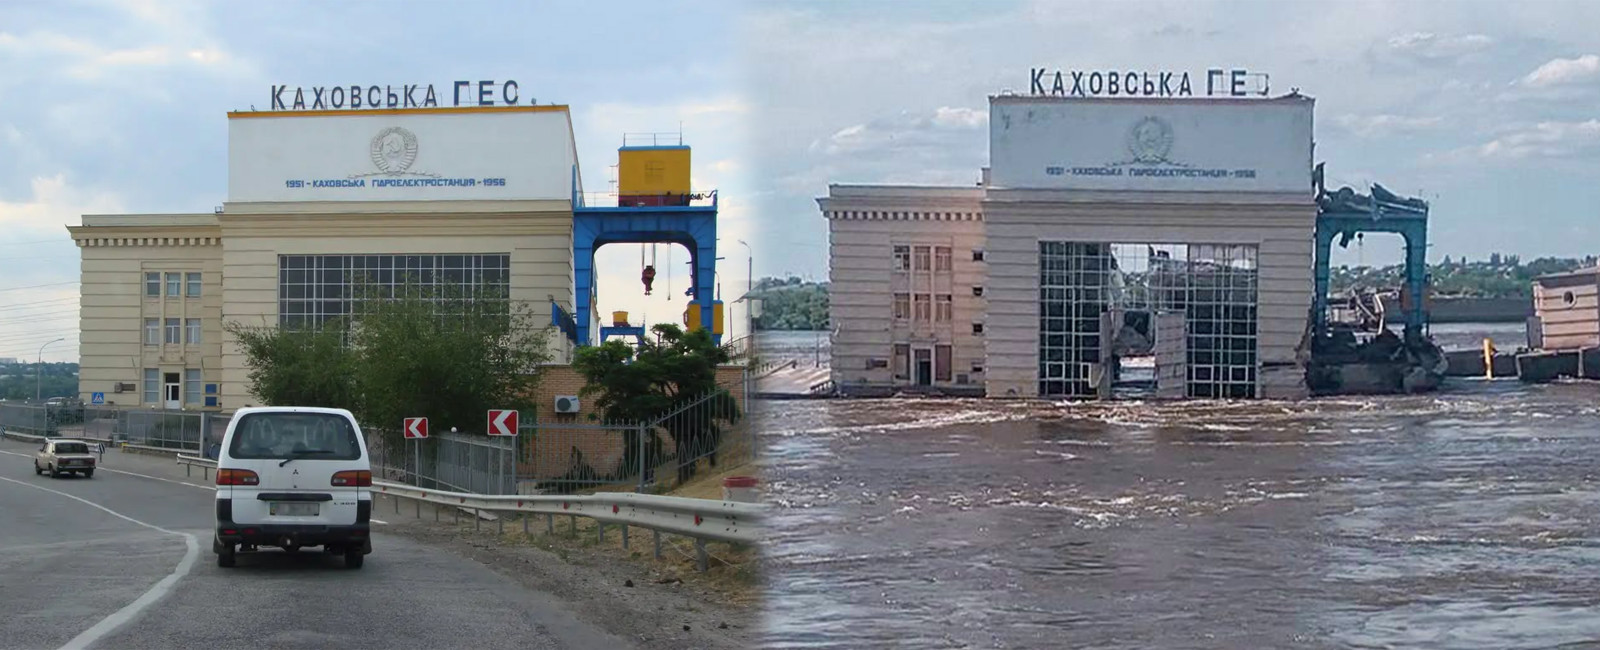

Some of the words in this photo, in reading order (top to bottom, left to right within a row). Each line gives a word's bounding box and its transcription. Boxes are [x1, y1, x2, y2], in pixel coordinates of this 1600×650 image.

[271, 84, 437, 110] КАХОВСЬКА
[453, 79, 519, 106] ГЕС
[1030, 68, 1192, 97] КАХОВСЬКА
[285, 180, 304, 188] 1951
[312, 179, 365, 188] КАХОВСЬКА
[372, 178, 475, 187] ГІДРОЕЛЕКТРОСТАНЦІЯ
[482, 178, 506, 186] 1956
